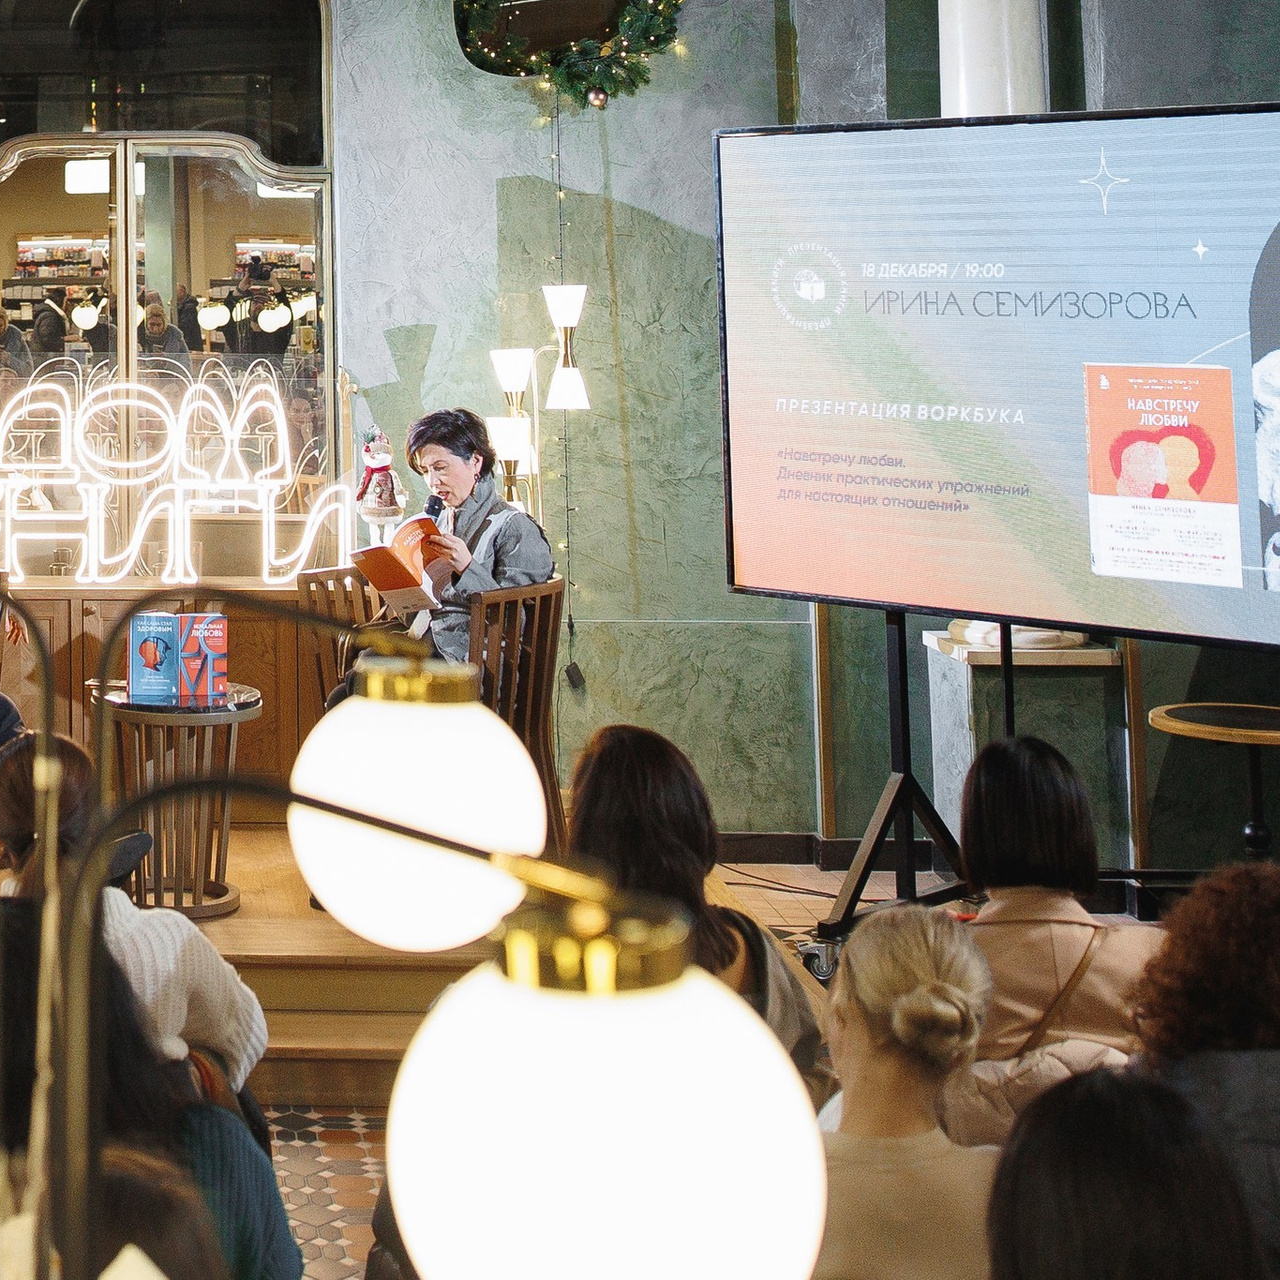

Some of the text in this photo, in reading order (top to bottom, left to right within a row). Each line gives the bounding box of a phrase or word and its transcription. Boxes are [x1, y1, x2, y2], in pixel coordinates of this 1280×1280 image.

[861, 262, 875, 278] 18
[878, 262, 948, 280] ДЕКАБРЯ
[965, 262, 1005, 279] 19:00
[863, 289, 1198, 320] ИРИНА СЕМИЗОРОВА
[775, 398, 1026, 425] ПРЕЗЕНТАЦИЯ ВОРКБУКА
[1127, 397, 1201, 413] НАВСТРЕЧУ
[1139, 413, 1189, 427] ЛЮБВИ
[777, 447, 907, 468] «Навстречу любви.
[777, 466, 833, 483] Дневник
[836, 473, 934, 490] практических
[777, 488, 970, 513] для настоящих отношений»
[137, 625, 173, 633] ЗДОРОВЫМ
[191, 629, 224, 637] ЛЮБОВЬ
